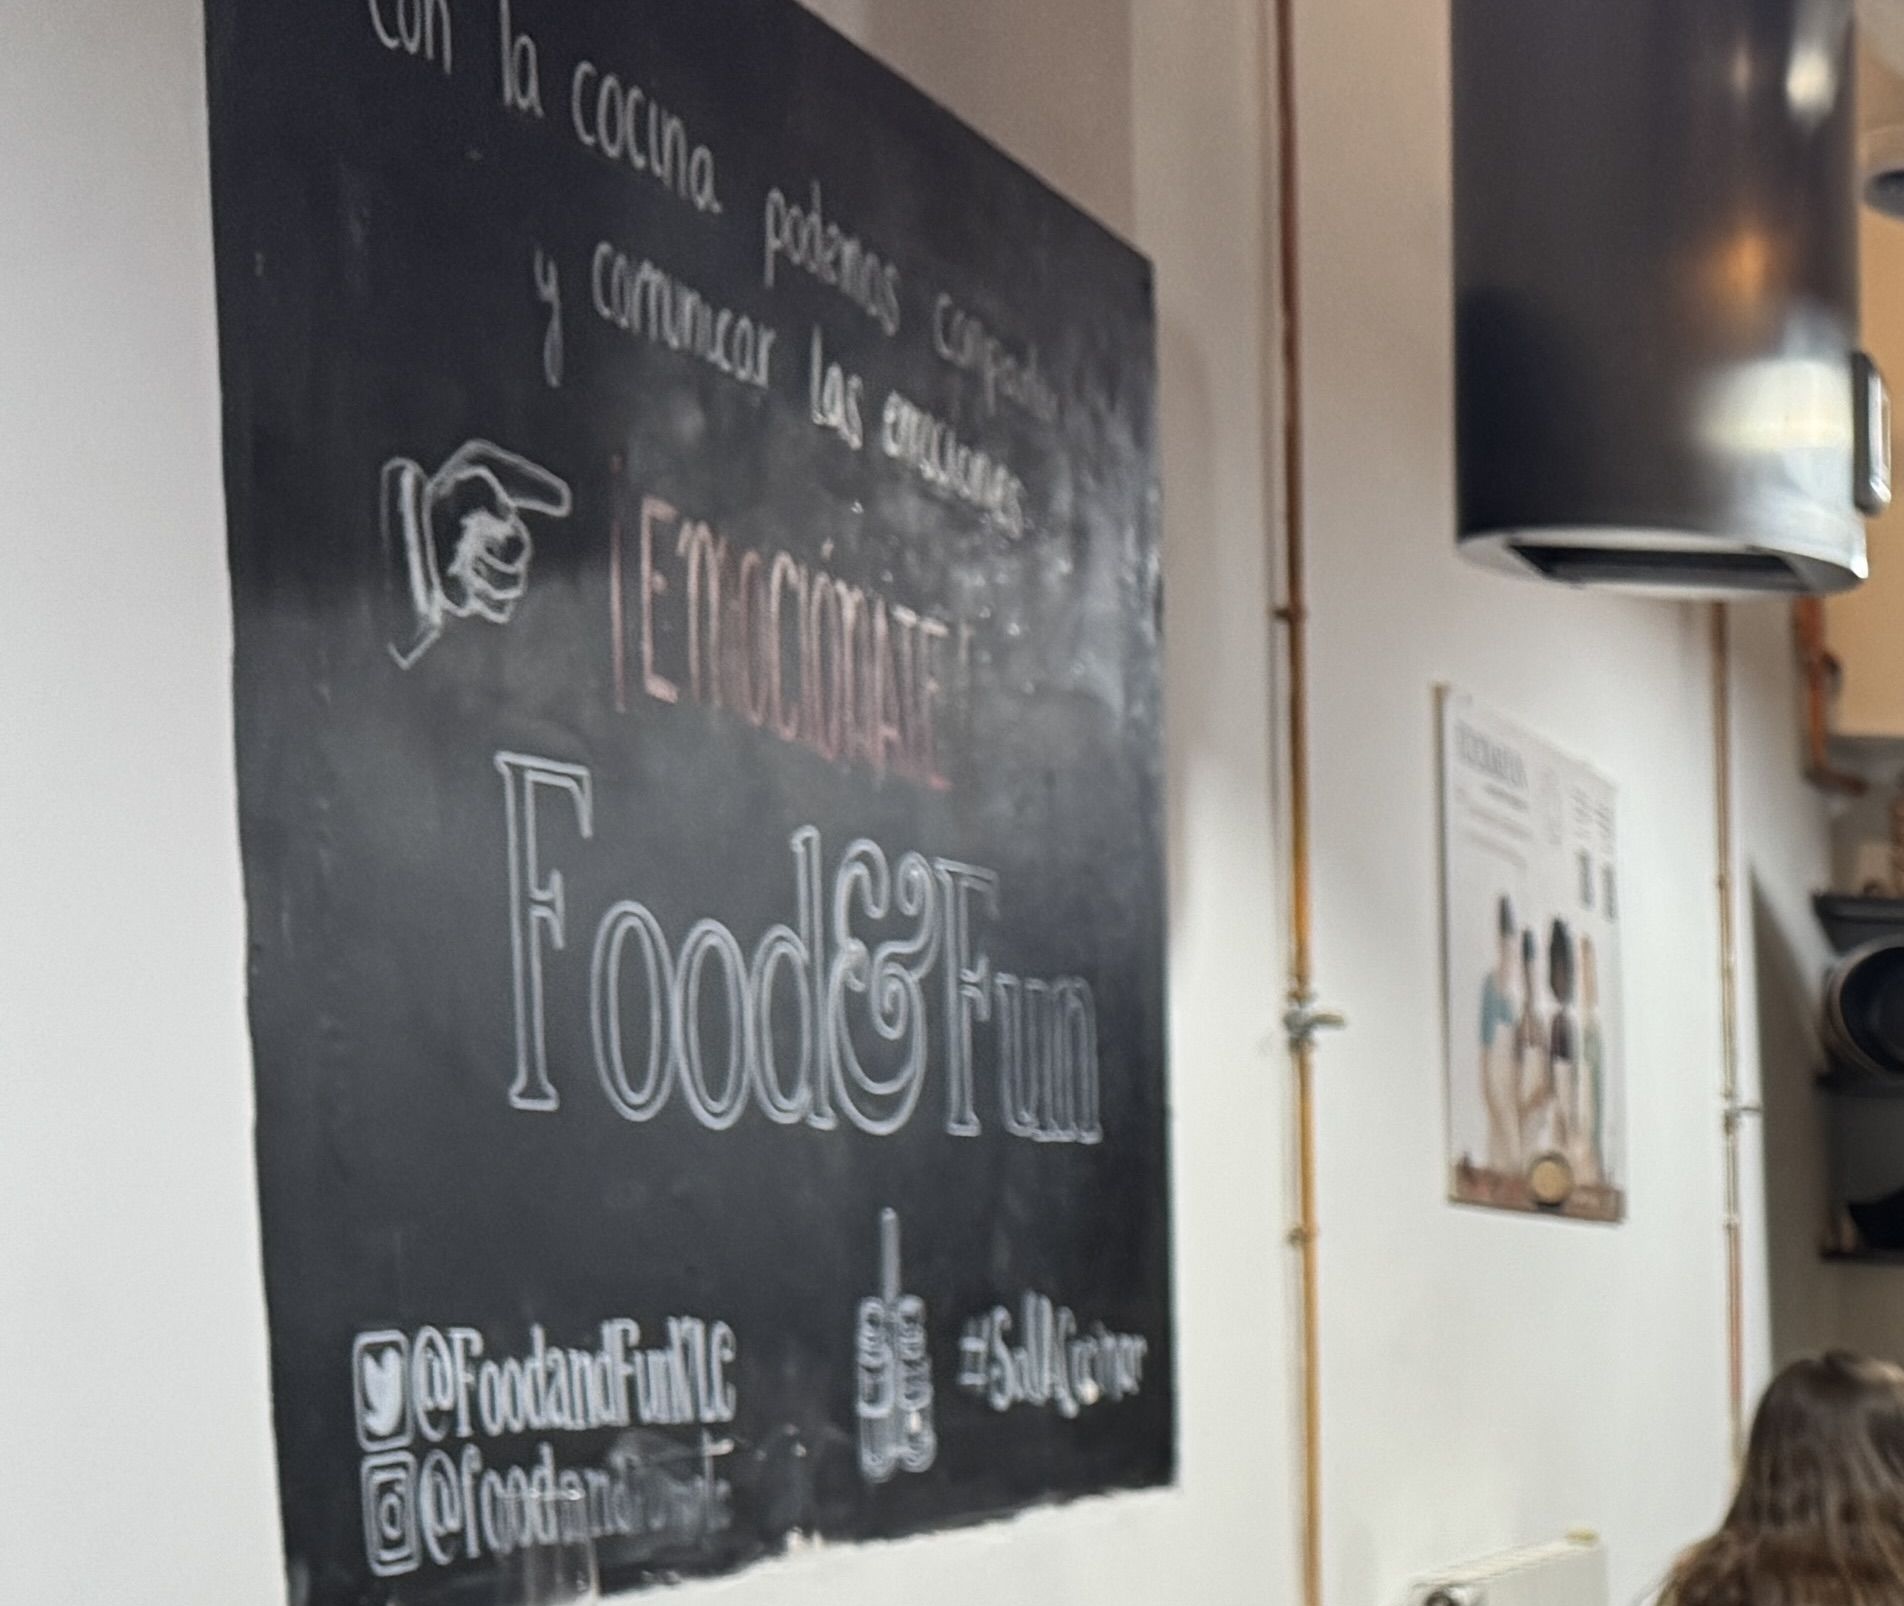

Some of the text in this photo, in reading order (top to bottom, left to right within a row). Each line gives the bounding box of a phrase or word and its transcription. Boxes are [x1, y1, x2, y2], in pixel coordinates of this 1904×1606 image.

[499, 0, 545, 119] la
[571, 59, 723, 214] cocina
[534, 246, 565, 389] y
[592, 241, 777, 391] comunicar
[810, 324, 864, 451] las
